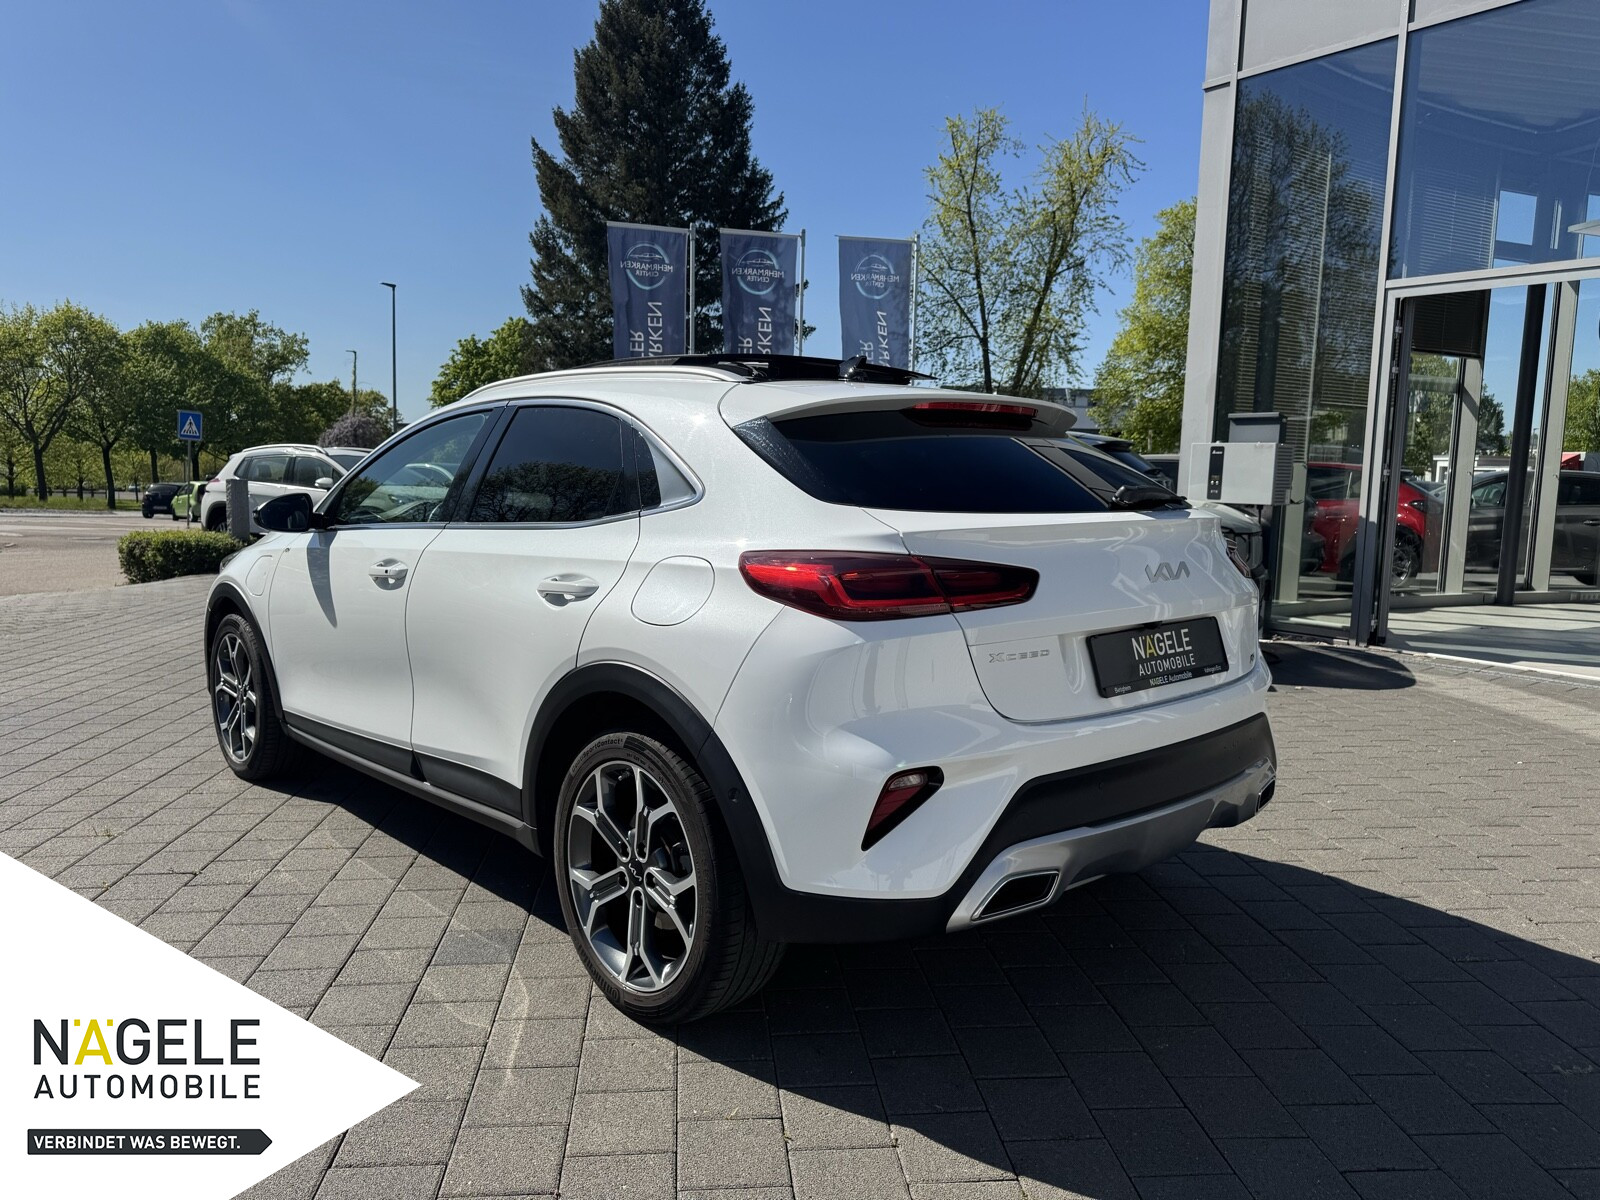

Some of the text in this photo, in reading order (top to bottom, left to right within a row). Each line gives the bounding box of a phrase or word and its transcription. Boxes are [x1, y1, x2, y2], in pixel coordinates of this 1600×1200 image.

[1131, 628, 1193, 661] NÄGELE
[1139, 653, 1196, 677] AUTOMOBILE
[1168, 670, 1193, 682] Automobile
